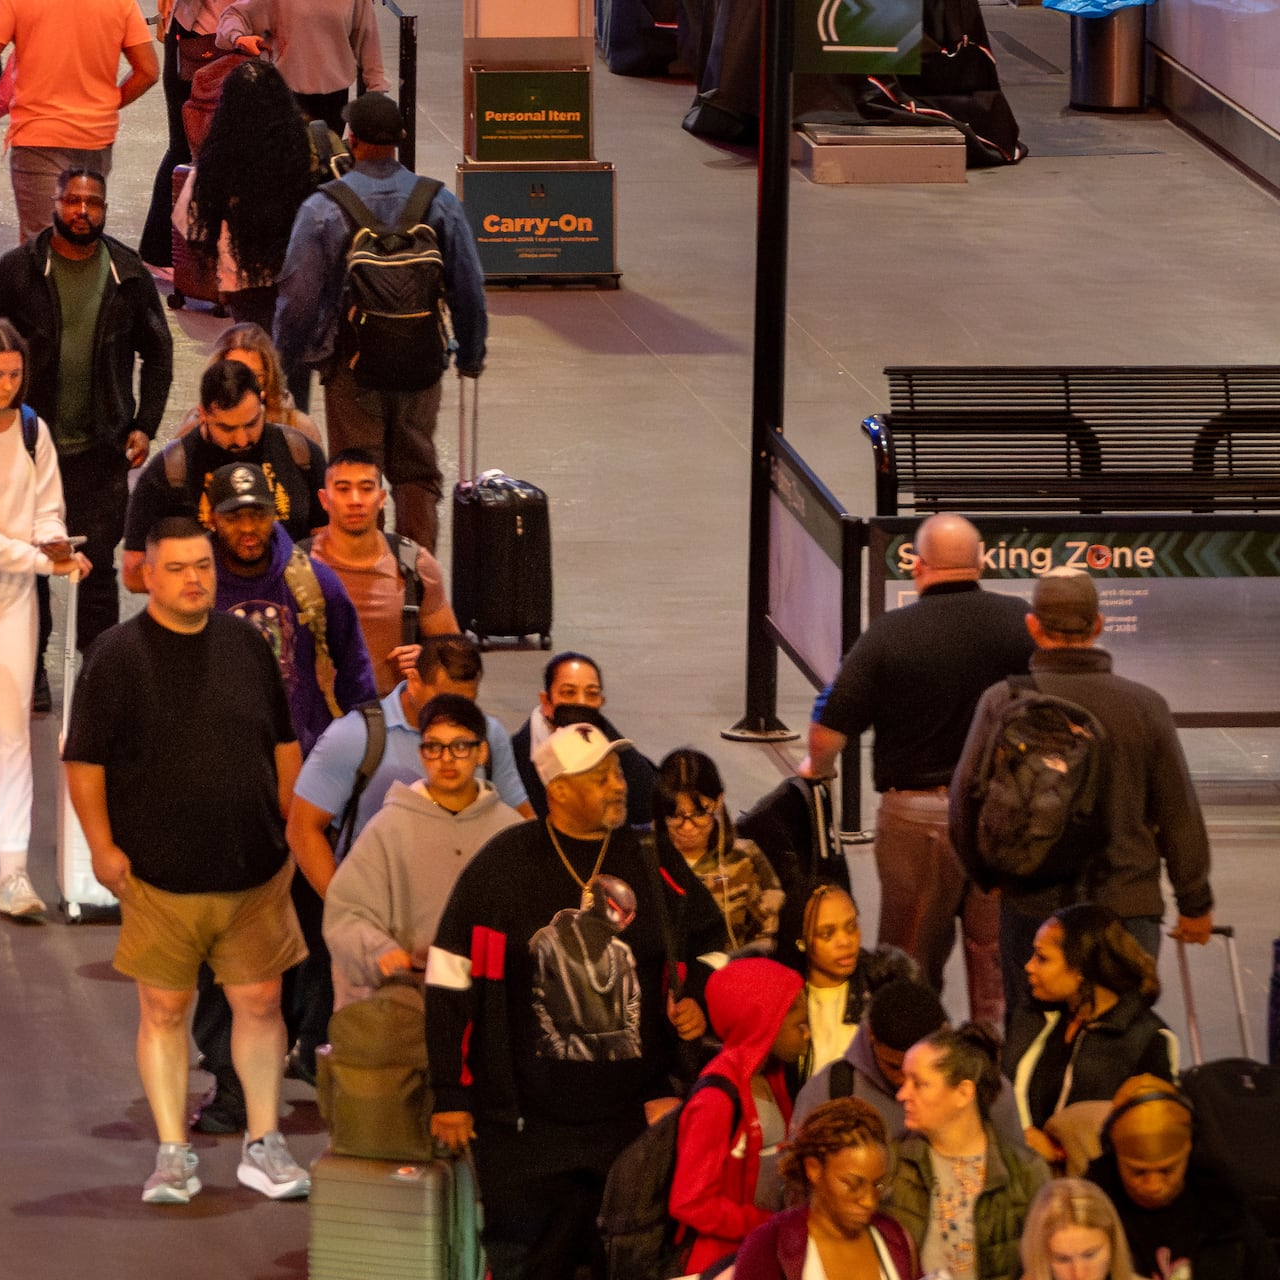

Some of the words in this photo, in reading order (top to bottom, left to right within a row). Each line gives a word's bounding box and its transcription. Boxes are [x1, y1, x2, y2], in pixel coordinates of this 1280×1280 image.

[485, 110, 546, 121] Personal
[549, 110, 581, 121] Item
[483, 214, 593, 235] Carry-On
[897, 541, 1053, 574] Sking
